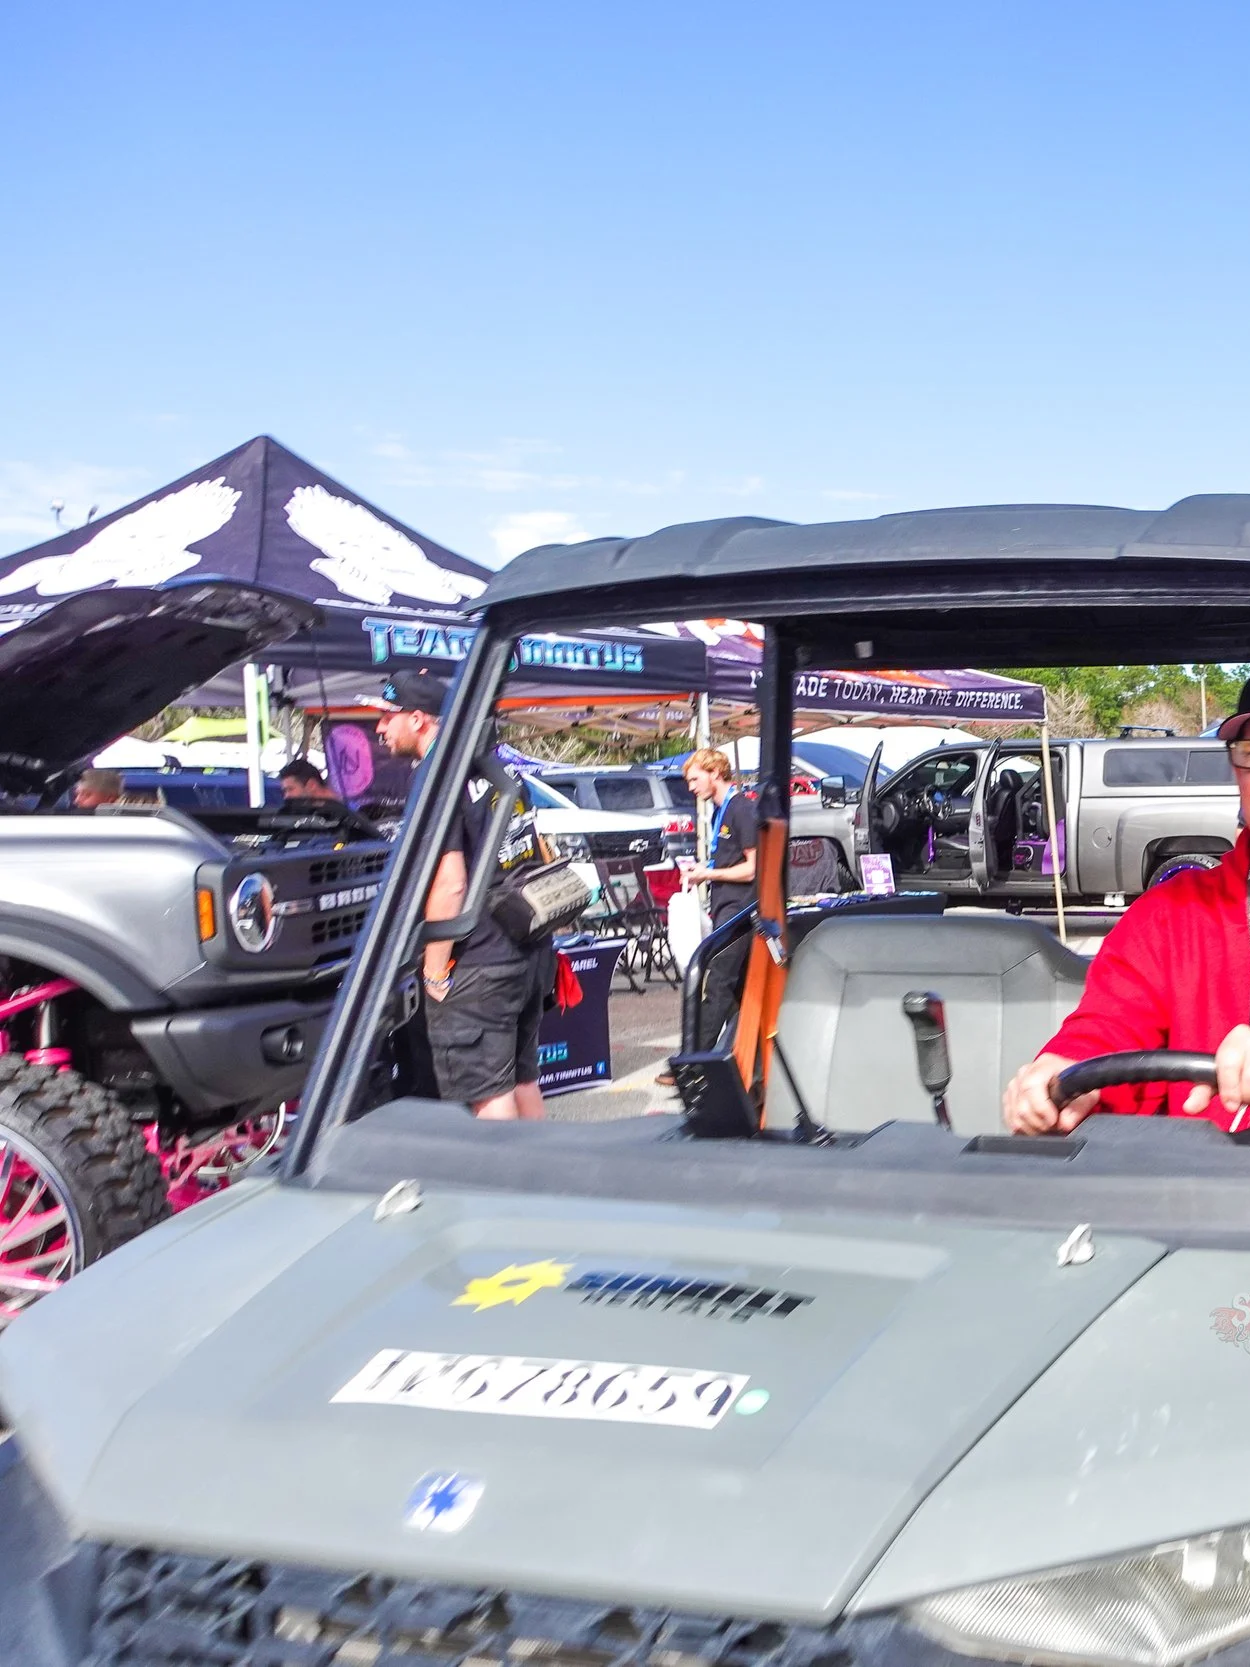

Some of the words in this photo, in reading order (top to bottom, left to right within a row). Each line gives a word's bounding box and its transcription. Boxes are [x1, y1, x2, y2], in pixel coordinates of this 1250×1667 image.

[508, 631, 646, 674] INNITUS
[833, 678, 885, 705] TODAY,
[888, 686, 926, 705] HEAR
[929, 688, 953, 707] THE
[954, 691, 1025, 711] DIFFERENCE.
[319, 882, 382, 912] BRON
[571, 957, 599, 973] AREL
[537, 1065, 593, 1086] AM.TINNITUS
